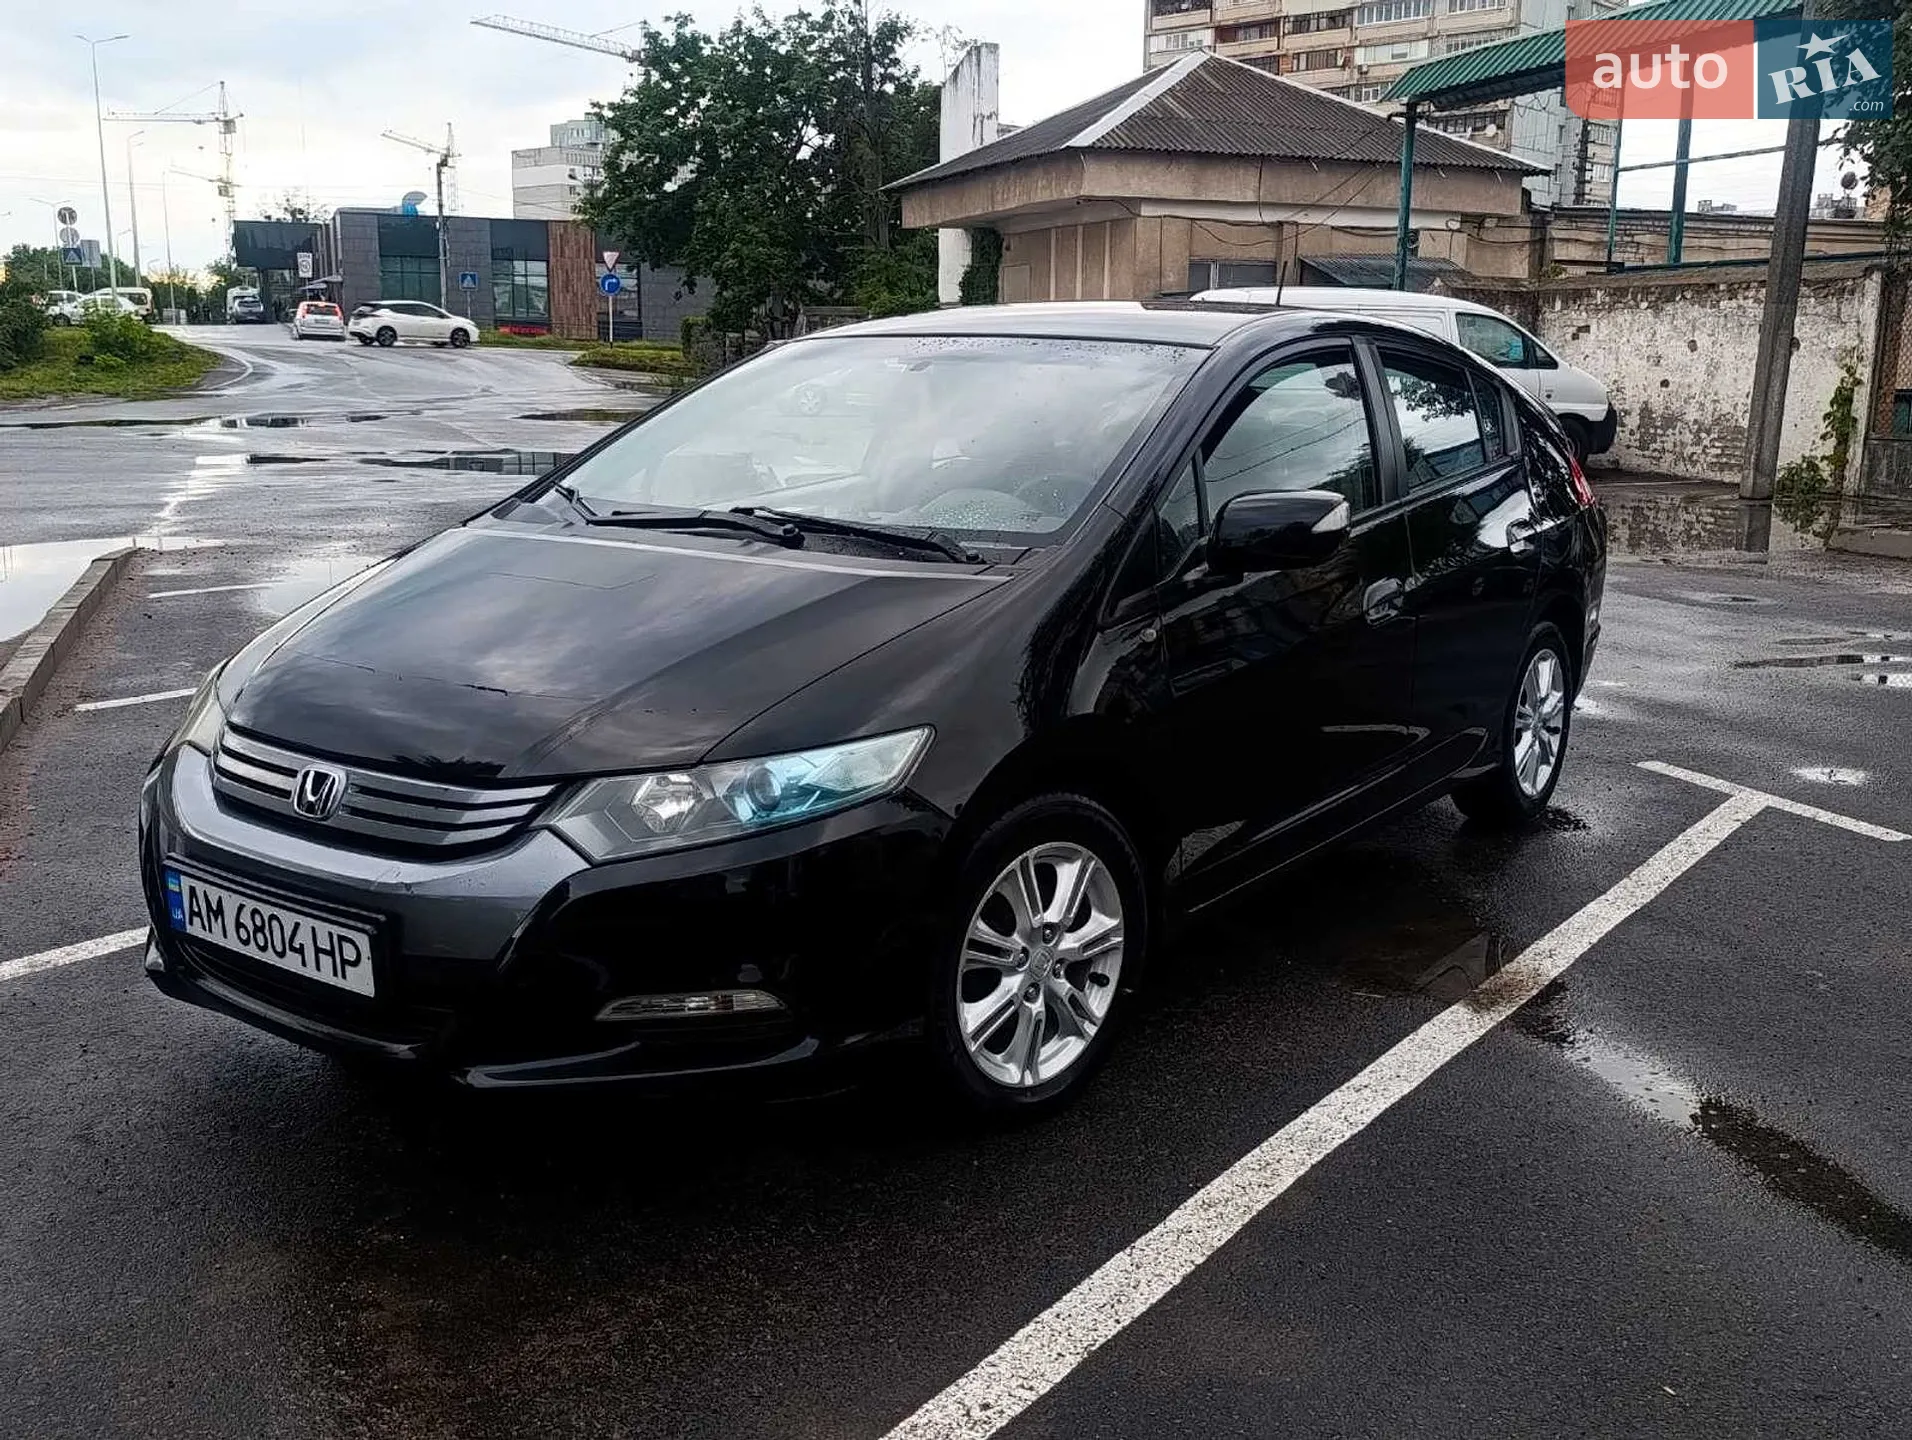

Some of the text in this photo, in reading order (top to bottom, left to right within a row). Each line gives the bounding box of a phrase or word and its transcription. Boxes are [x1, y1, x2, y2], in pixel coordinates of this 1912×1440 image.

[188, 884, 362, 981] AM 6804 HP
